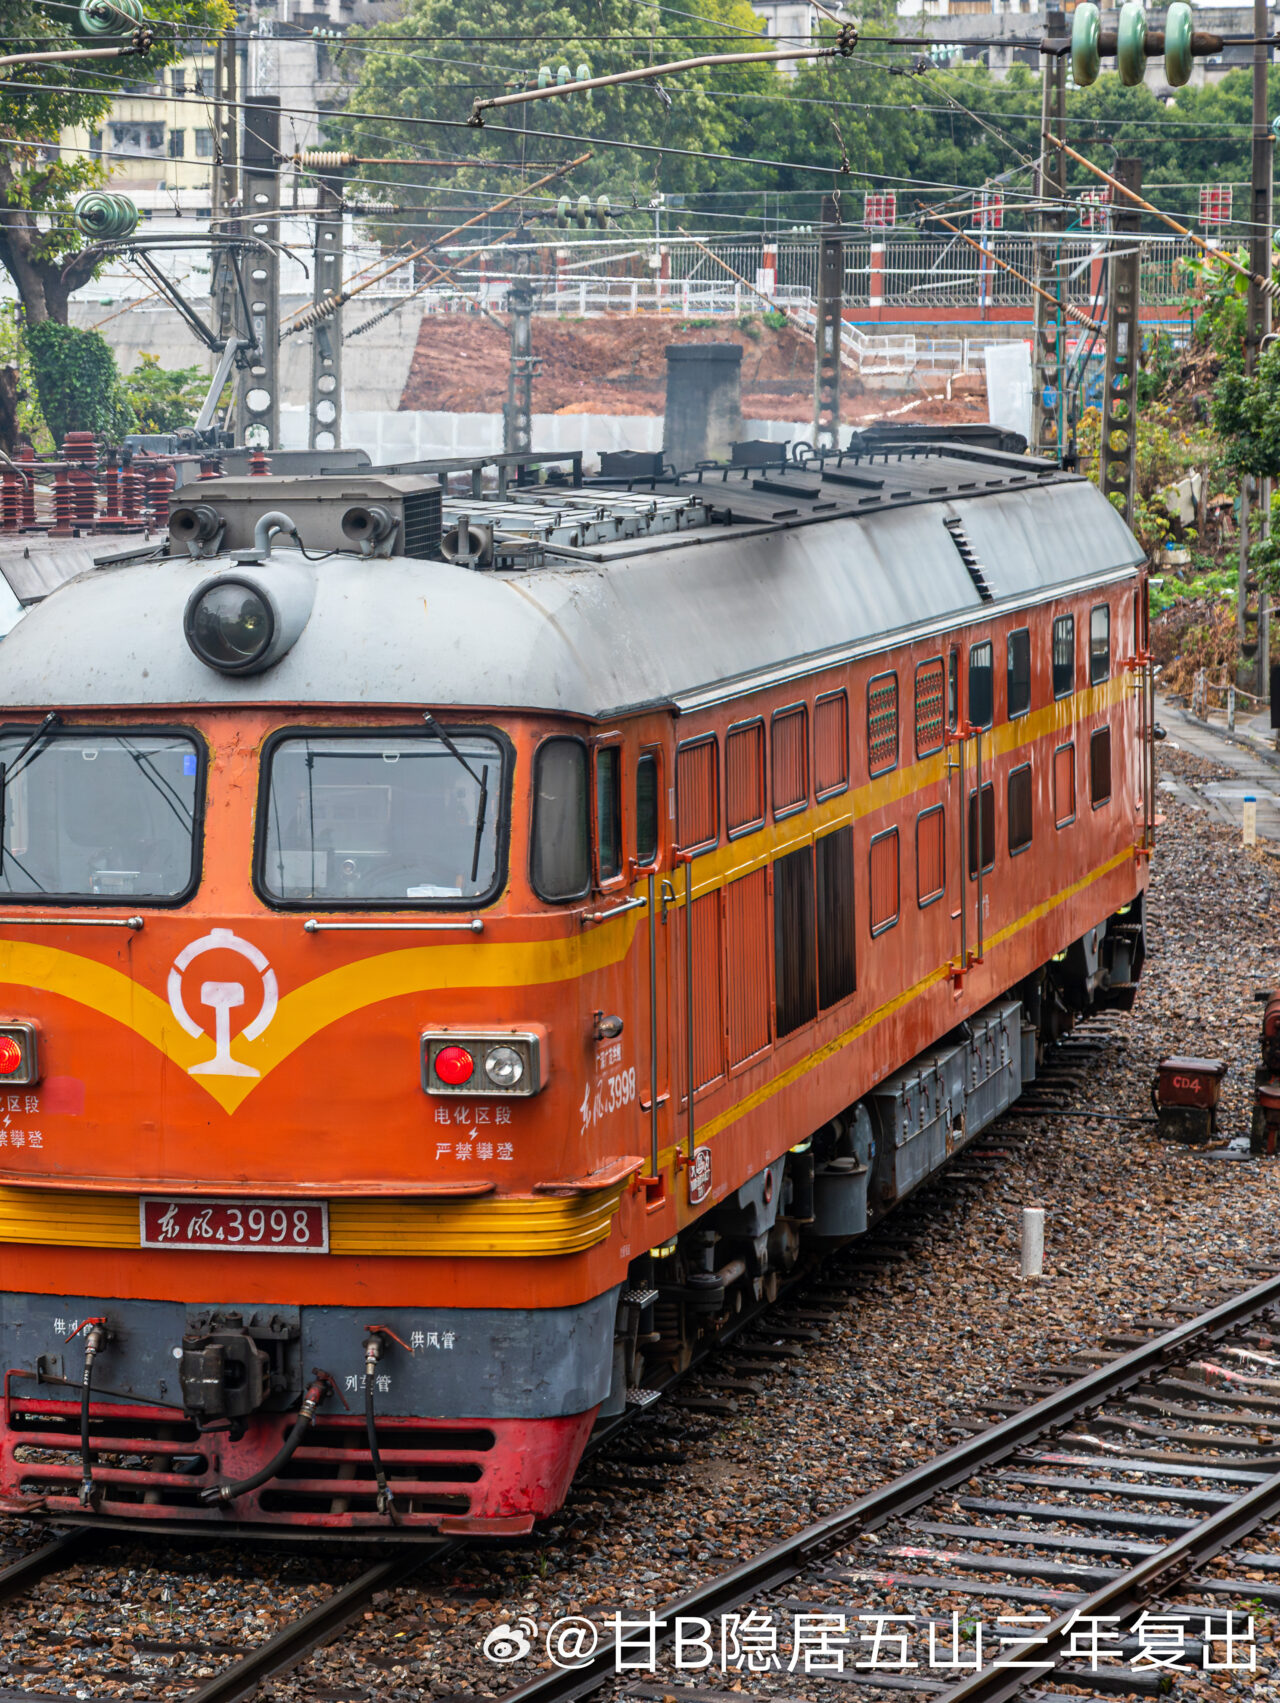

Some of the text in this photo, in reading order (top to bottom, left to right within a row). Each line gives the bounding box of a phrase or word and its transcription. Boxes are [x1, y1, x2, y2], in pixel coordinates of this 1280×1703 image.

[1172, 1076, 1201, 1093] CD4
[434, 1105, 512, 1125] 电化区段
[435, 1141, 514, 1161] 严禁攀登
[410, 1331, 456, 1350] 供风管
